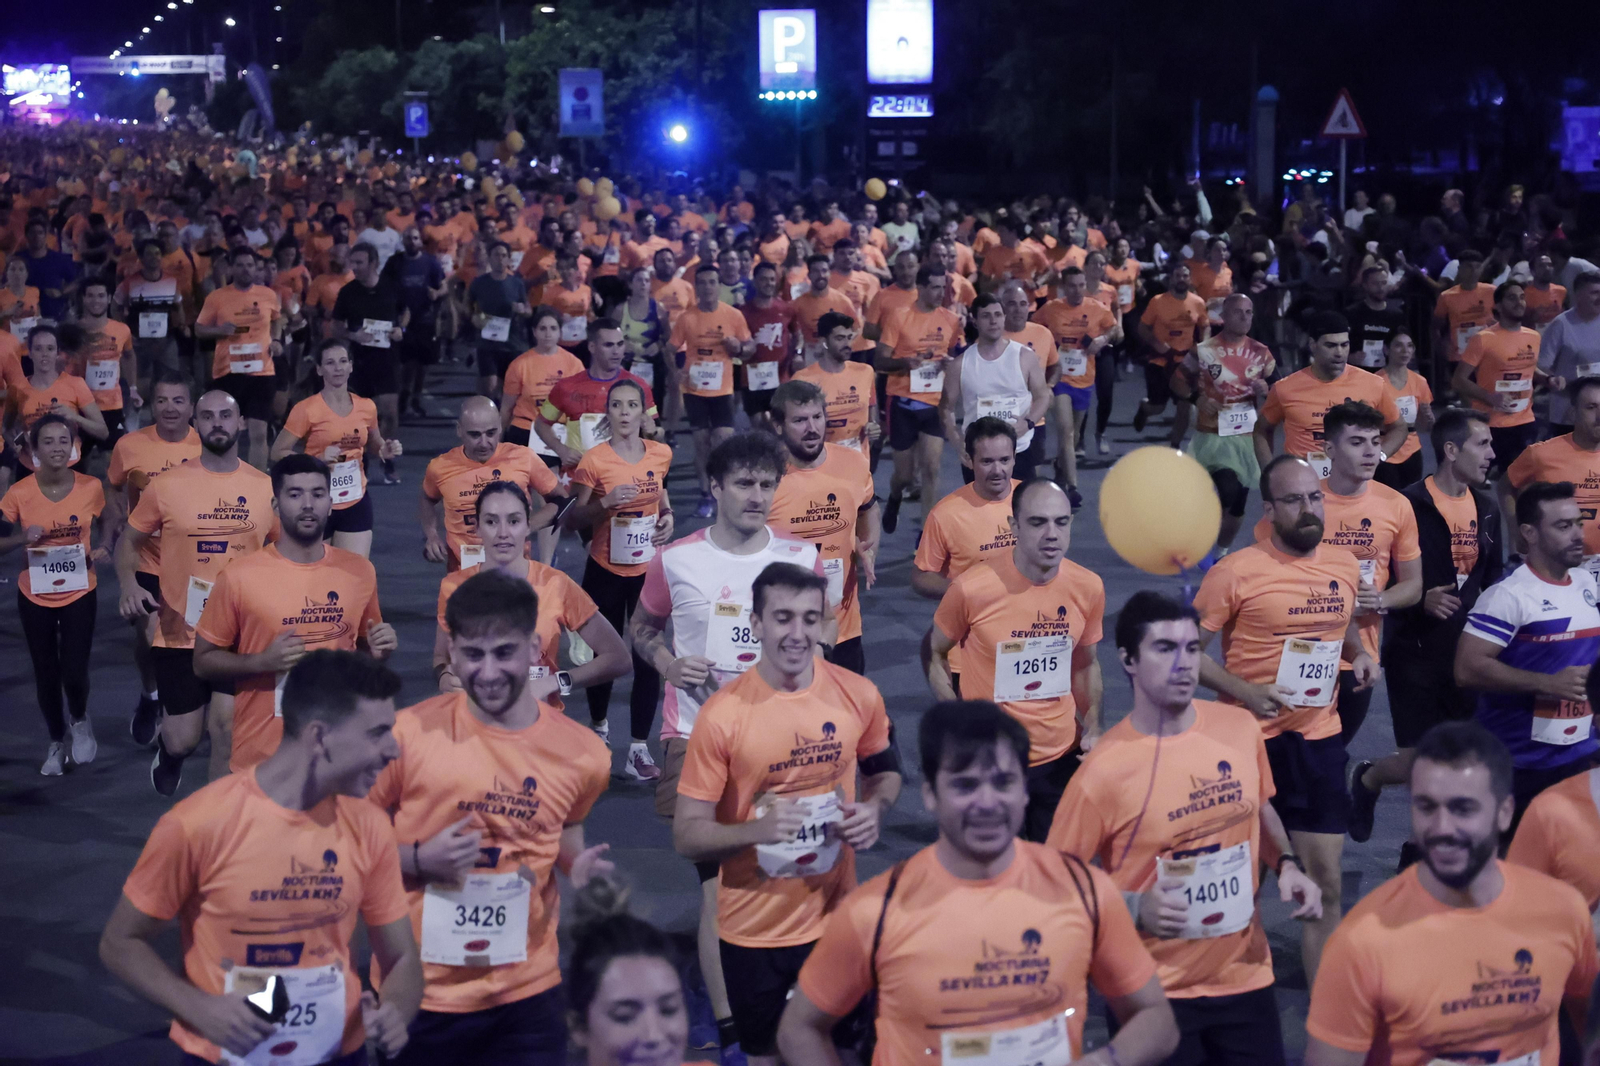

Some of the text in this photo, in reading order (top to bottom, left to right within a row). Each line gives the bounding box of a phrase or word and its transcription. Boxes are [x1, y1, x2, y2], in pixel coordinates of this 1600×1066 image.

[774, 17, 805, 62] P
[870, 96, 928, 112] 22:04
[1230, 413, 1248, 422] 3715
[332, 475, 353, 487] 8669
[790, 513, 840, 523] SEVILLA KH7
[806, 507, 840, 515] NOCTURNA
[627, 533, 649, 544] 7164
[1353, 538, 1373, 546] KH7
[980, 541, 1011, 552] SEVILLA
[42, 561, 76, 574] 14069
[1307, 597, 1344, 606] NOCTURNA
[301, 607, 344, 615] NOCTURNA
[1288, 604, 1344, 616] SEVILLA KH7
[282, 614, 343, 625] SEVILLA KH7
[1010, 630, 1049, 638] SEVILLA
[1013, 657, 1057, 675] 12615
[1298, 663, 1334, 679] 12813
[790, 742, 842, 757] NOCTURNA
[769, 751, 842, 773] SEVILLA KH7
[1189, 780, 1242, 801] NOCTURNA
[485, 792, 540, 809] NOCTURNA
[1167, 790, 1243, 822] SEVILLA KH7
[457, 801, 536, 821] SEVILLA KH7
[282, 876, 343, 887] NOCTURNA
[250, 887, 342, 902] SEVILLA KH7
[1184, 876, 1239, 905] 14010
[455, 905, 506, 927] 3426
[975, 957, 1050, 973] NOCTURNA
[939, 970, 1049, 992] SEVILLA KH7
[1472, 976, 1541, 993] NOCTURNA
[1441, 988, 1541, 1016] SEVILLA KH7
